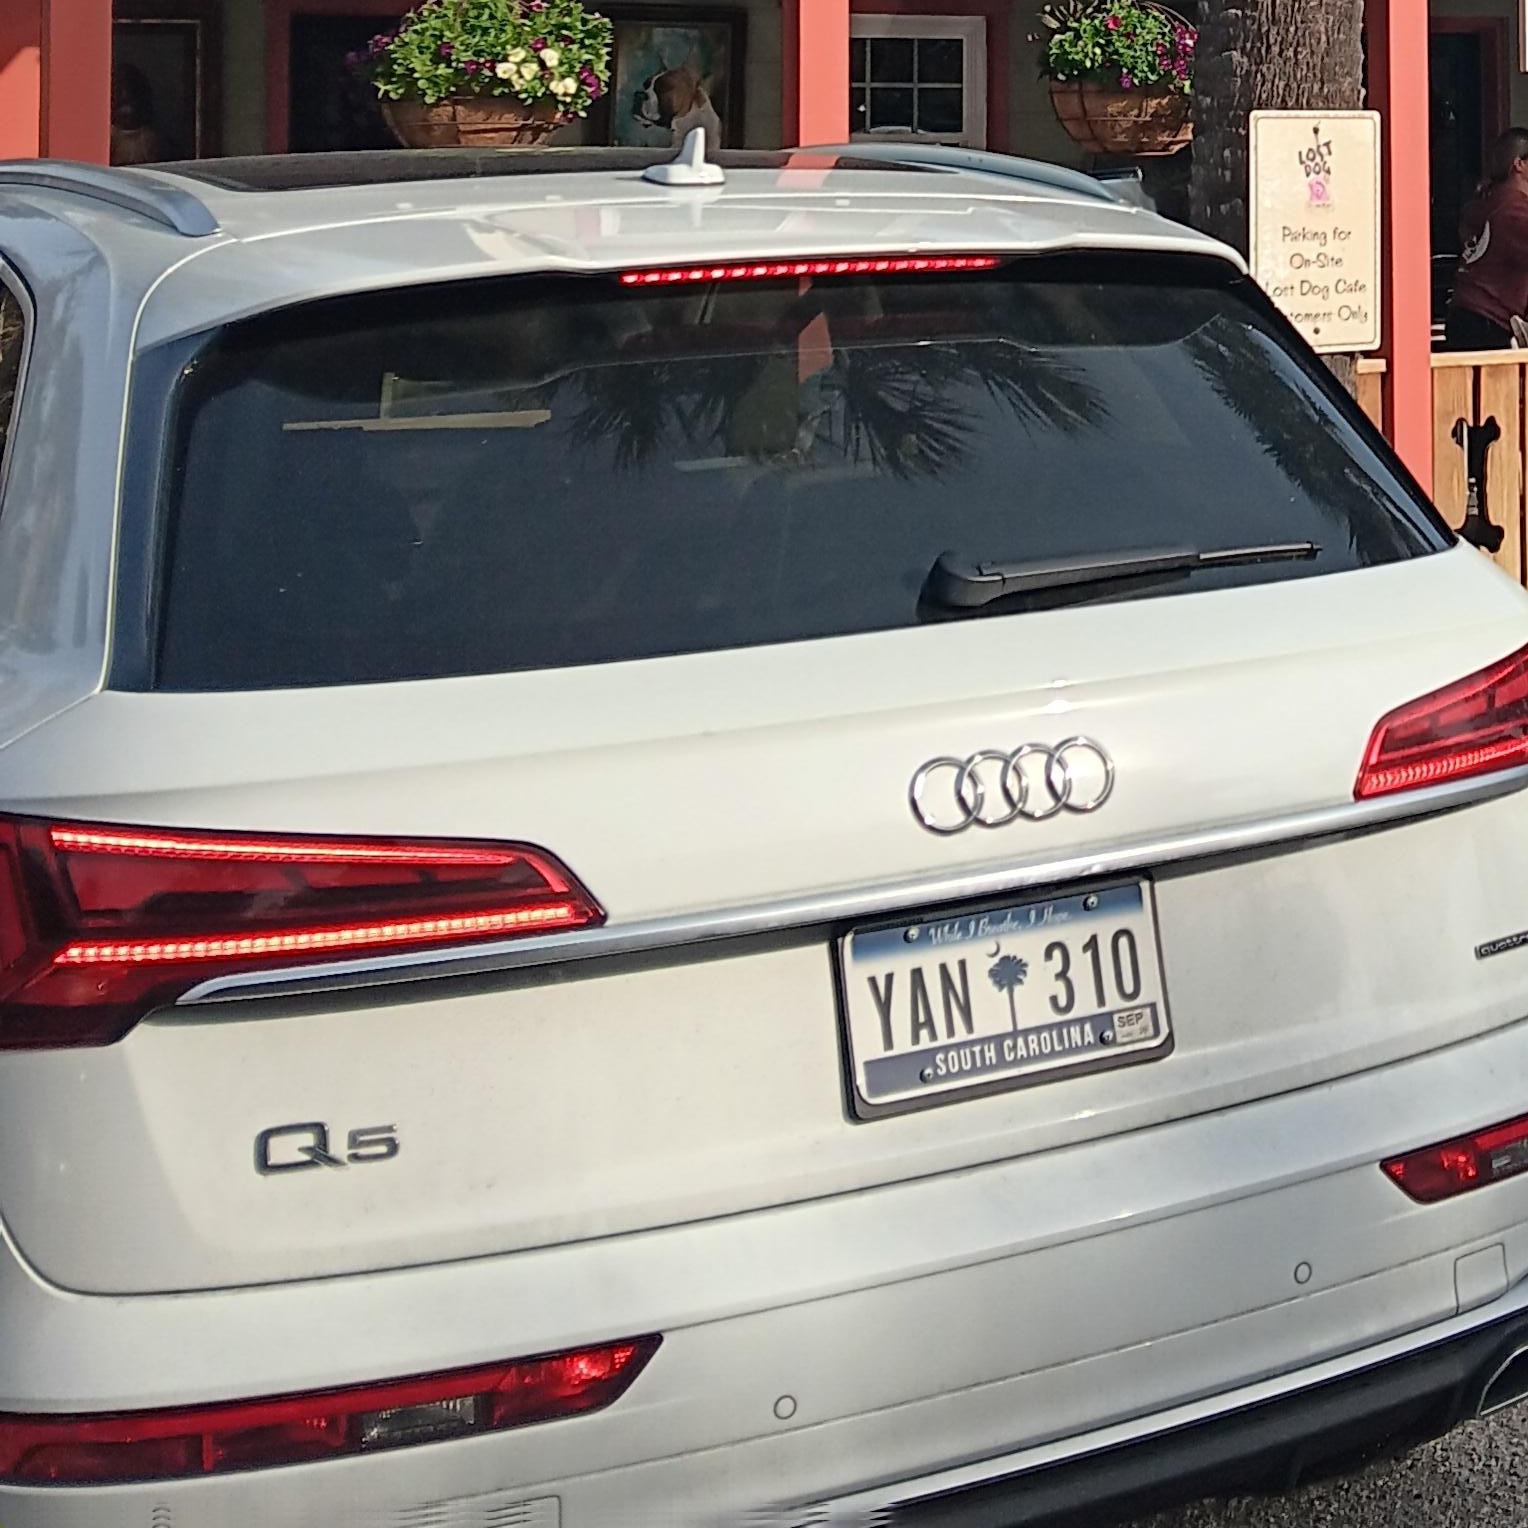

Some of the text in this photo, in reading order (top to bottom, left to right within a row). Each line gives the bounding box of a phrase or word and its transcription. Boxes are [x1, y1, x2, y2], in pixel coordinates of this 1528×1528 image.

[1298, 140, 1332, 165] LOST
[1304, 160, 1332, 178] DOG
[1281, 225, 1352, 247] Parking for
[1289, 252, 1343, 270] On-Site
[1300, 279, 1330, 301] Dog
[1335, 278, 1367, 295] Cafe
[1338, 304, 1368, 324] Only
[867, 929, 1141, 1053] YAN 310
[1117, 1012, 1144, 1028] SEP
[935, 1022, 1094, 1076] SOUTH CAROLINA
[254, 1122, 399, 1176] Q5
